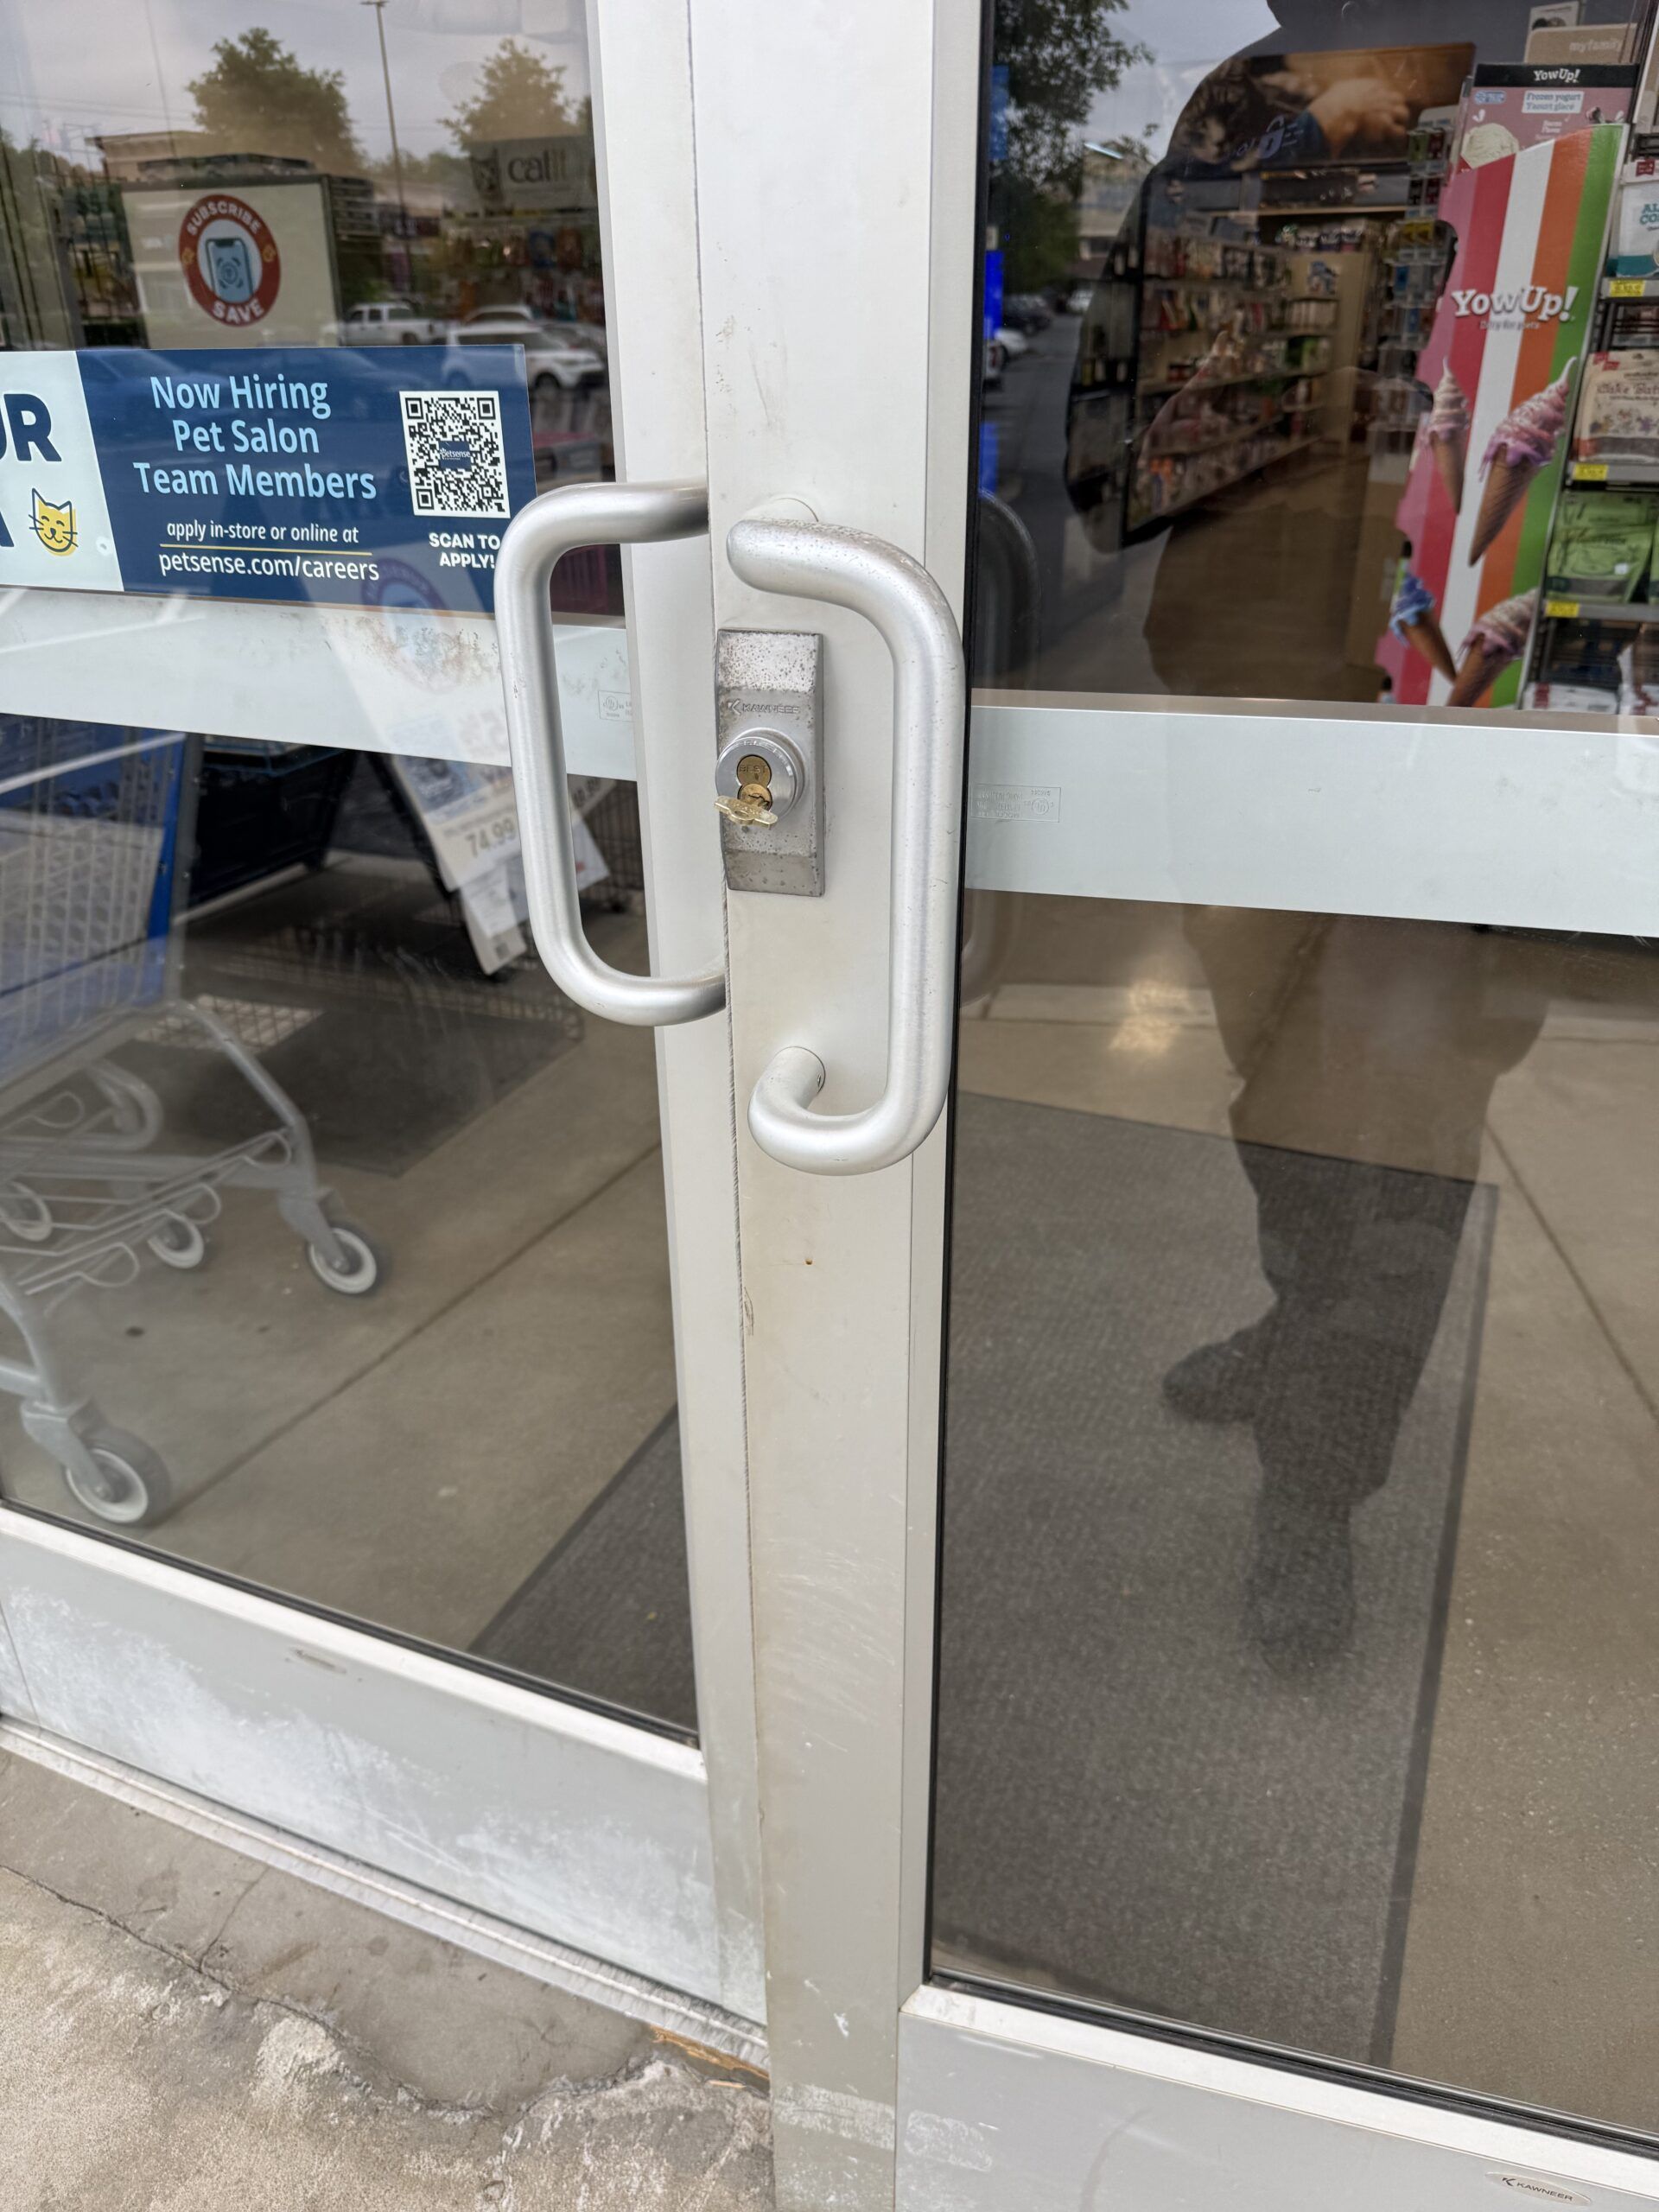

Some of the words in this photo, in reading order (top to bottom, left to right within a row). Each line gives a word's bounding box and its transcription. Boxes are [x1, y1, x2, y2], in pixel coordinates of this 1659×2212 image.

[1533, 68, 1581, 83] YowUp!
[187, 200, 262, 236] SUBSCRIBE
[213, 298, 264, 325] SAVE
[1452, 286, 1579, 322] YowUp!
[150, 376, 219, 409] Now
[229, 373, 331, 420] Hiring
[0, 394, 62, 461] R
[172, 419, 225, 452] Pet
[231, 418, 320, 454] Salon
[132, 462, 218, 494] Team
[226, 463, 377, 499] Members
[167, 519, 206, 542] apply
[210, 520, 265, 539] in-store
[270, 525, 287, 540] or
[290, 524, 338, 543] online
[342, 526, 359, 543] at
[429, 532, 474, 549] SCAN
[477, 534, 500, 550] TO
[159, 552, 379, 580] petsense.com/careers
[439, 551, 495, 569] APPLY!
[741, 703, 799, 715] KAWNEER
[739, 764, 767, 773] BEST
[1516, 2182, 1573, 2202] KAWNEER
